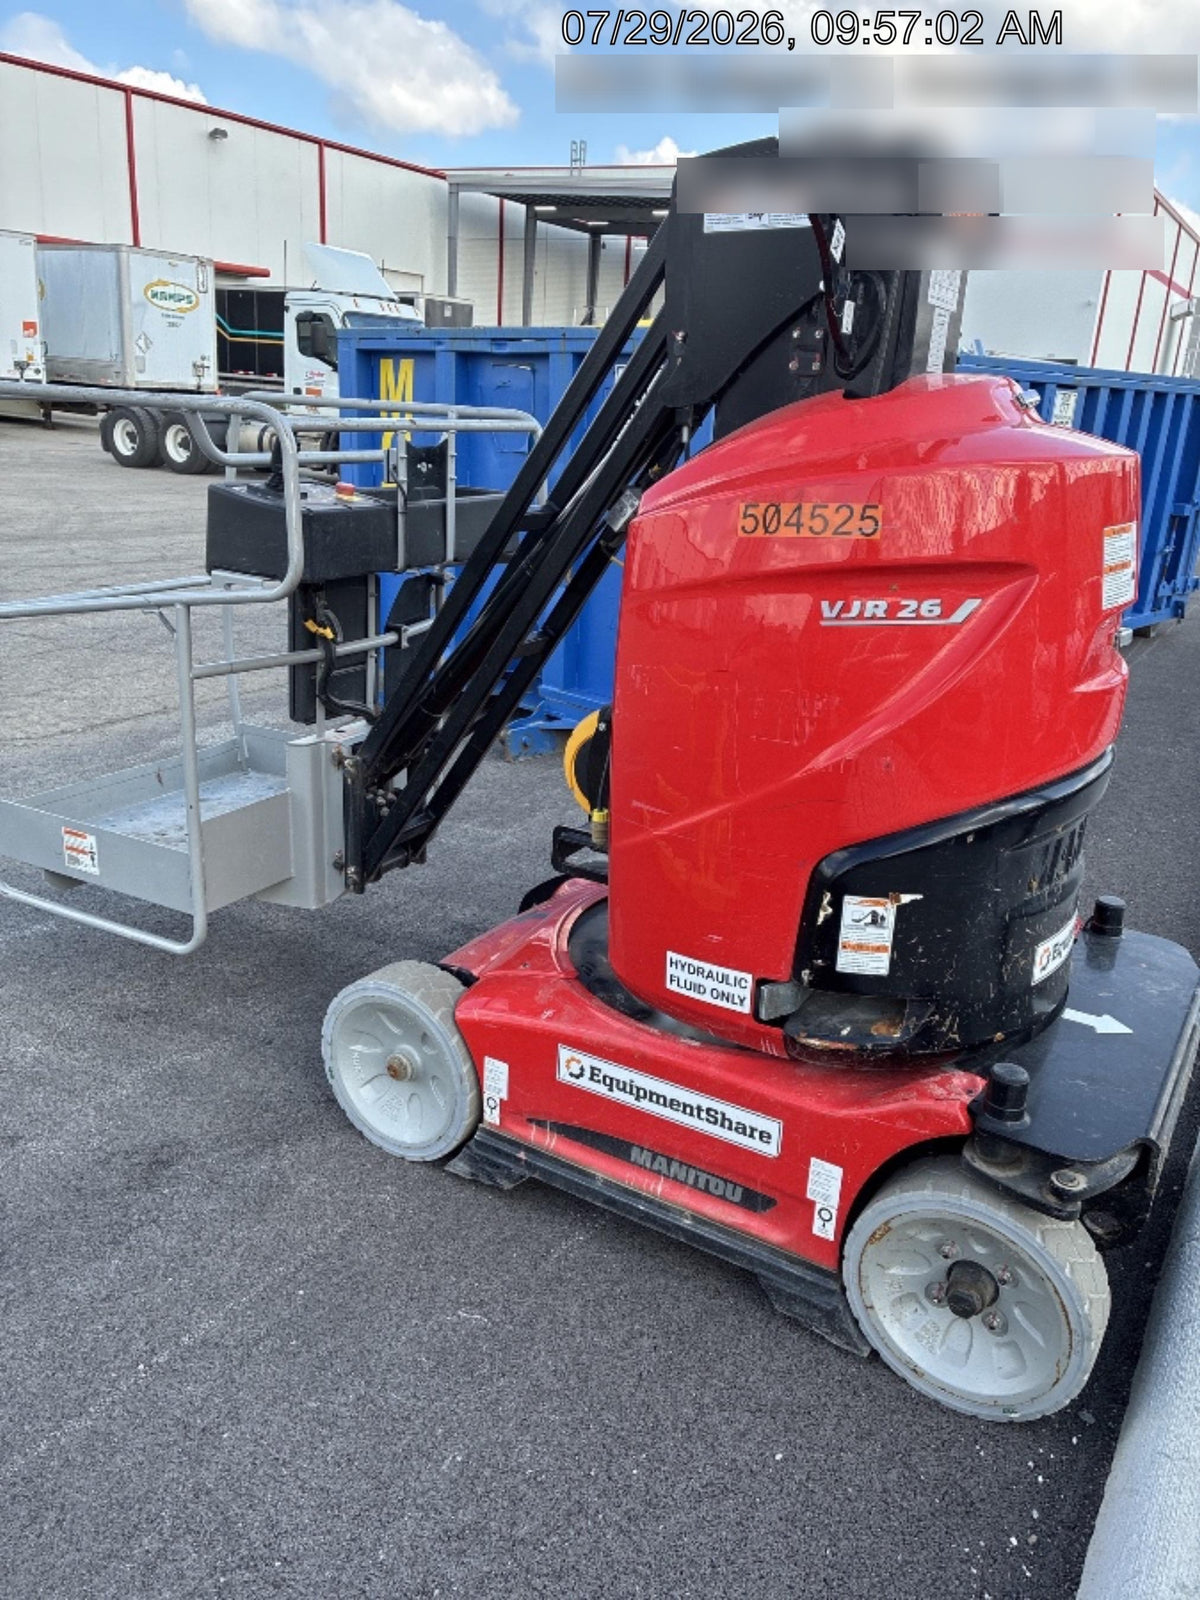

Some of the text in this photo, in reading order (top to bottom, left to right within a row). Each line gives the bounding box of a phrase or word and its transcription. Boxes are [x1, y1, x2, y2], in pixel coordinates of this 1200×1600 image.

[741, 503, 880, 537] 504525
[820, 599, 943, 619] VJR 26
[669, 956, 748, 990] HYDRAULIC
[669, 974, 746, 1007] FLUID ONLY
[588, 1065, 773, 1145] EquipmentShare
[630, 1146, 743, 1202] MANITOU
